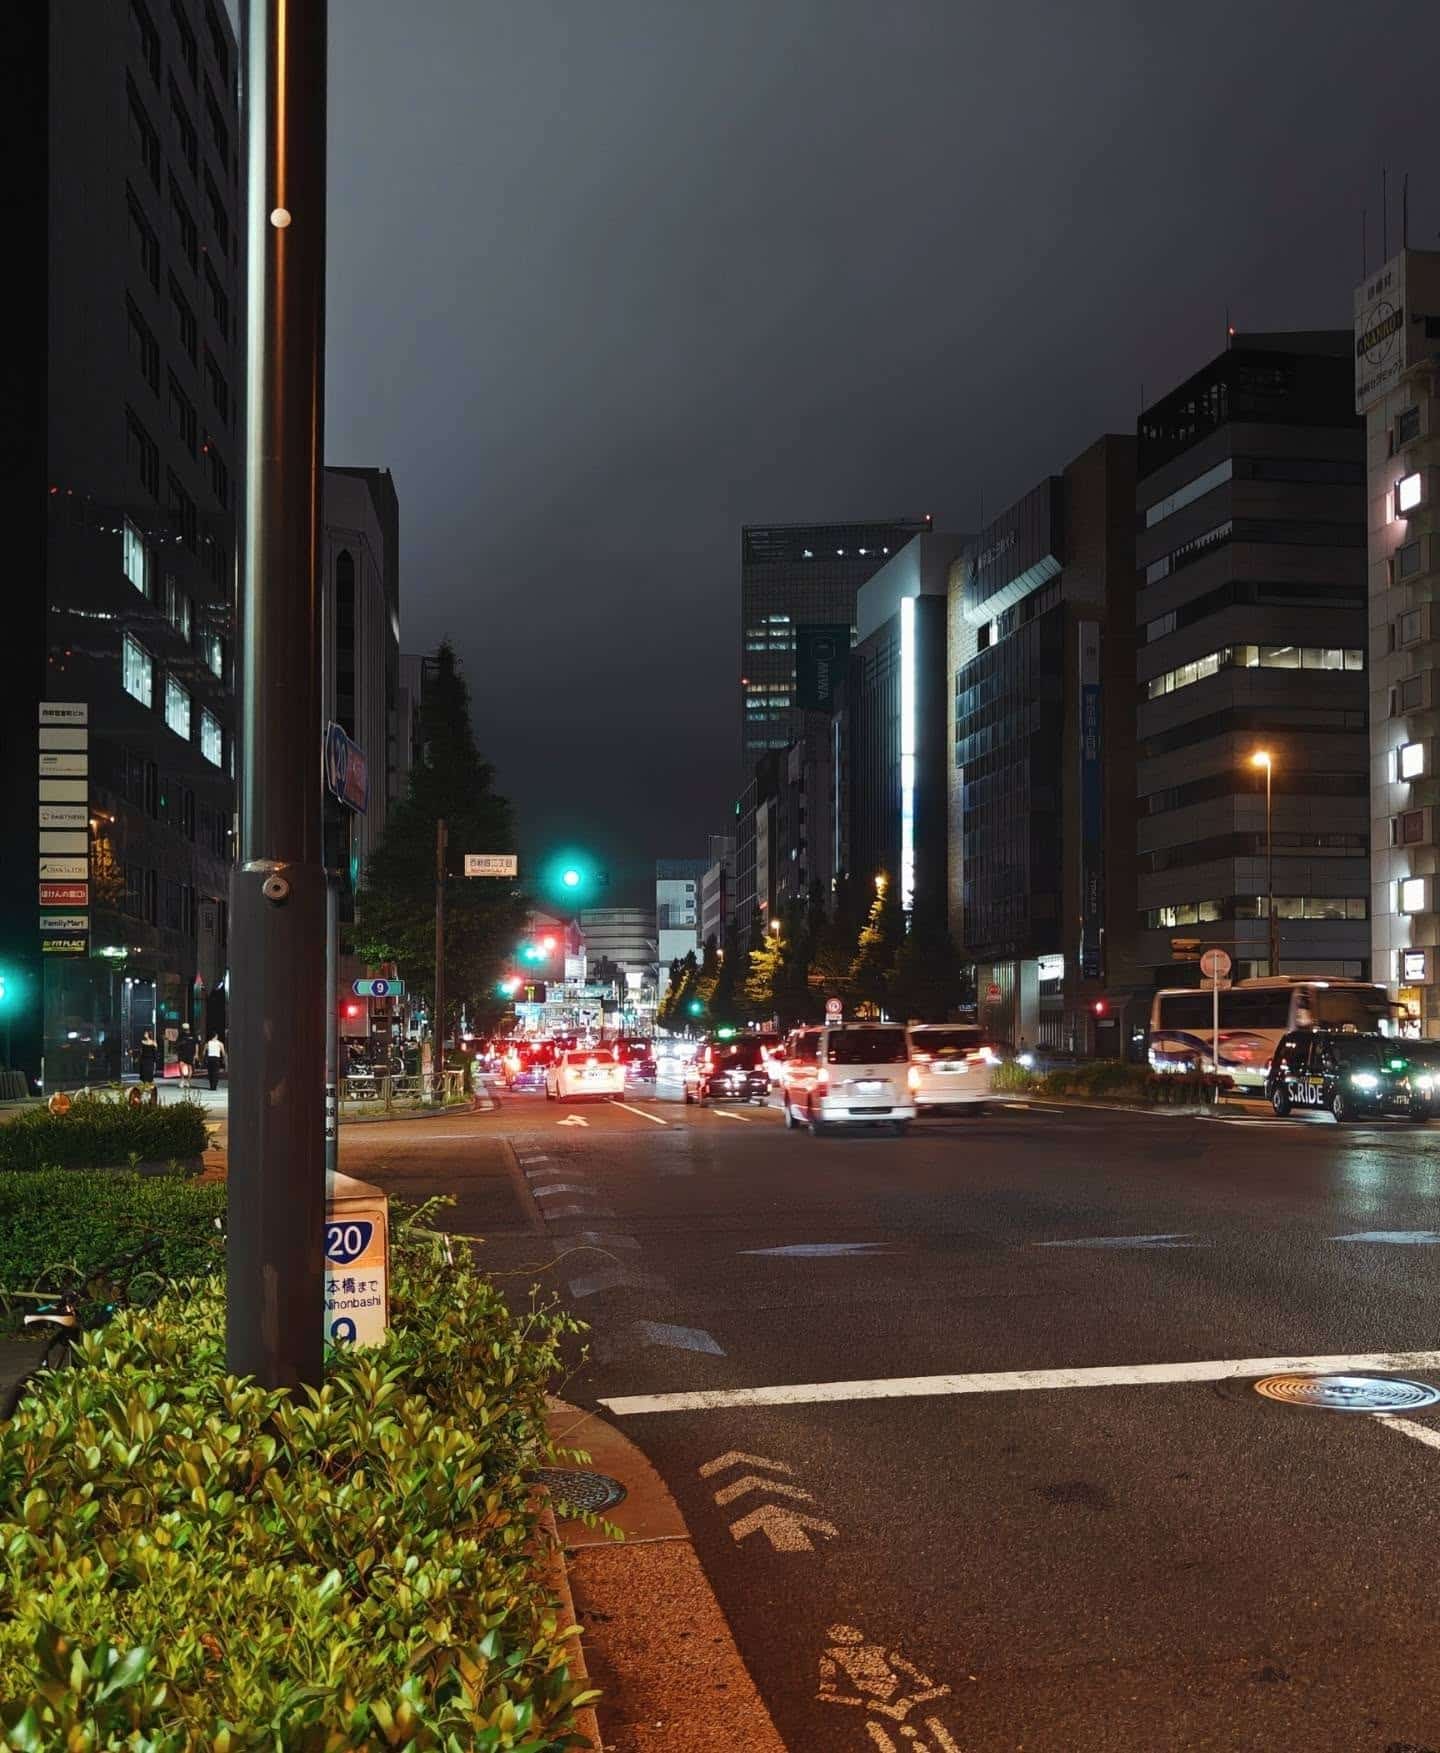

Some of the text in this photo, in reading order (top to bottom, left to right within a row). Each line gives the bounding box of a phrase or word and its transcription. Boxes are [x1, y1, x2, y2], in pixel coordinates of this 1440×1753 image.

[43, 919, 84, 928] FamilyMart
[376, 983, 384, 994] 9
[1288, 1081, 1324, 1105] S.RIDE
[327, 1225, 362, 1256] 20
[326, 1277, 379, 1295] 本橋まで
